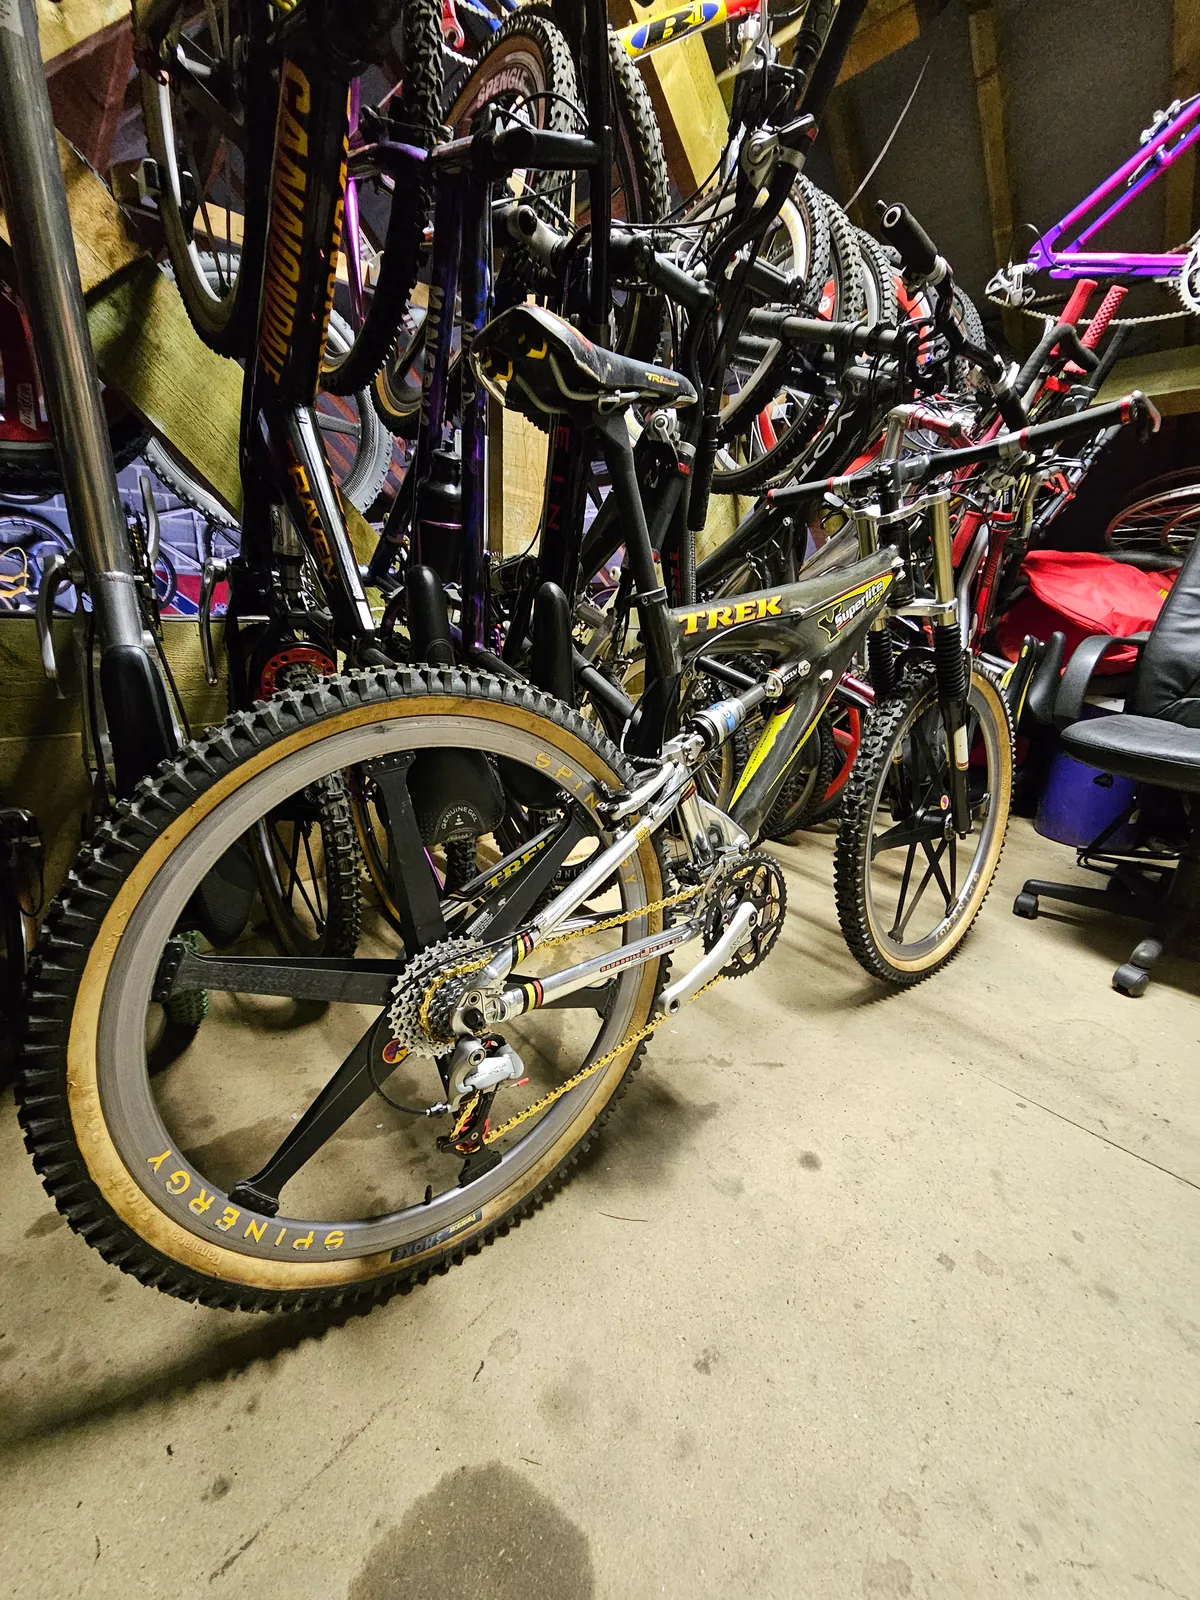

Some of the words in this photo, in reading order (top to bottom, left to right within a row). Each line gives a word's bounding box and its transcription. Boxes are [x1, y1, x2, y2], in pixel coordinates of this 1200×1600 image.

[476, 67, 529, 109] SPENGLE
[263, 57, 312, 385] CANNONDALE
[787, 410, 854, 489] VOTE
[678, 595, 782, 636] TREK
[146, 1149, 344, 1251] SPINERGY
[448, 1214, 477, 1234] Panaracer
